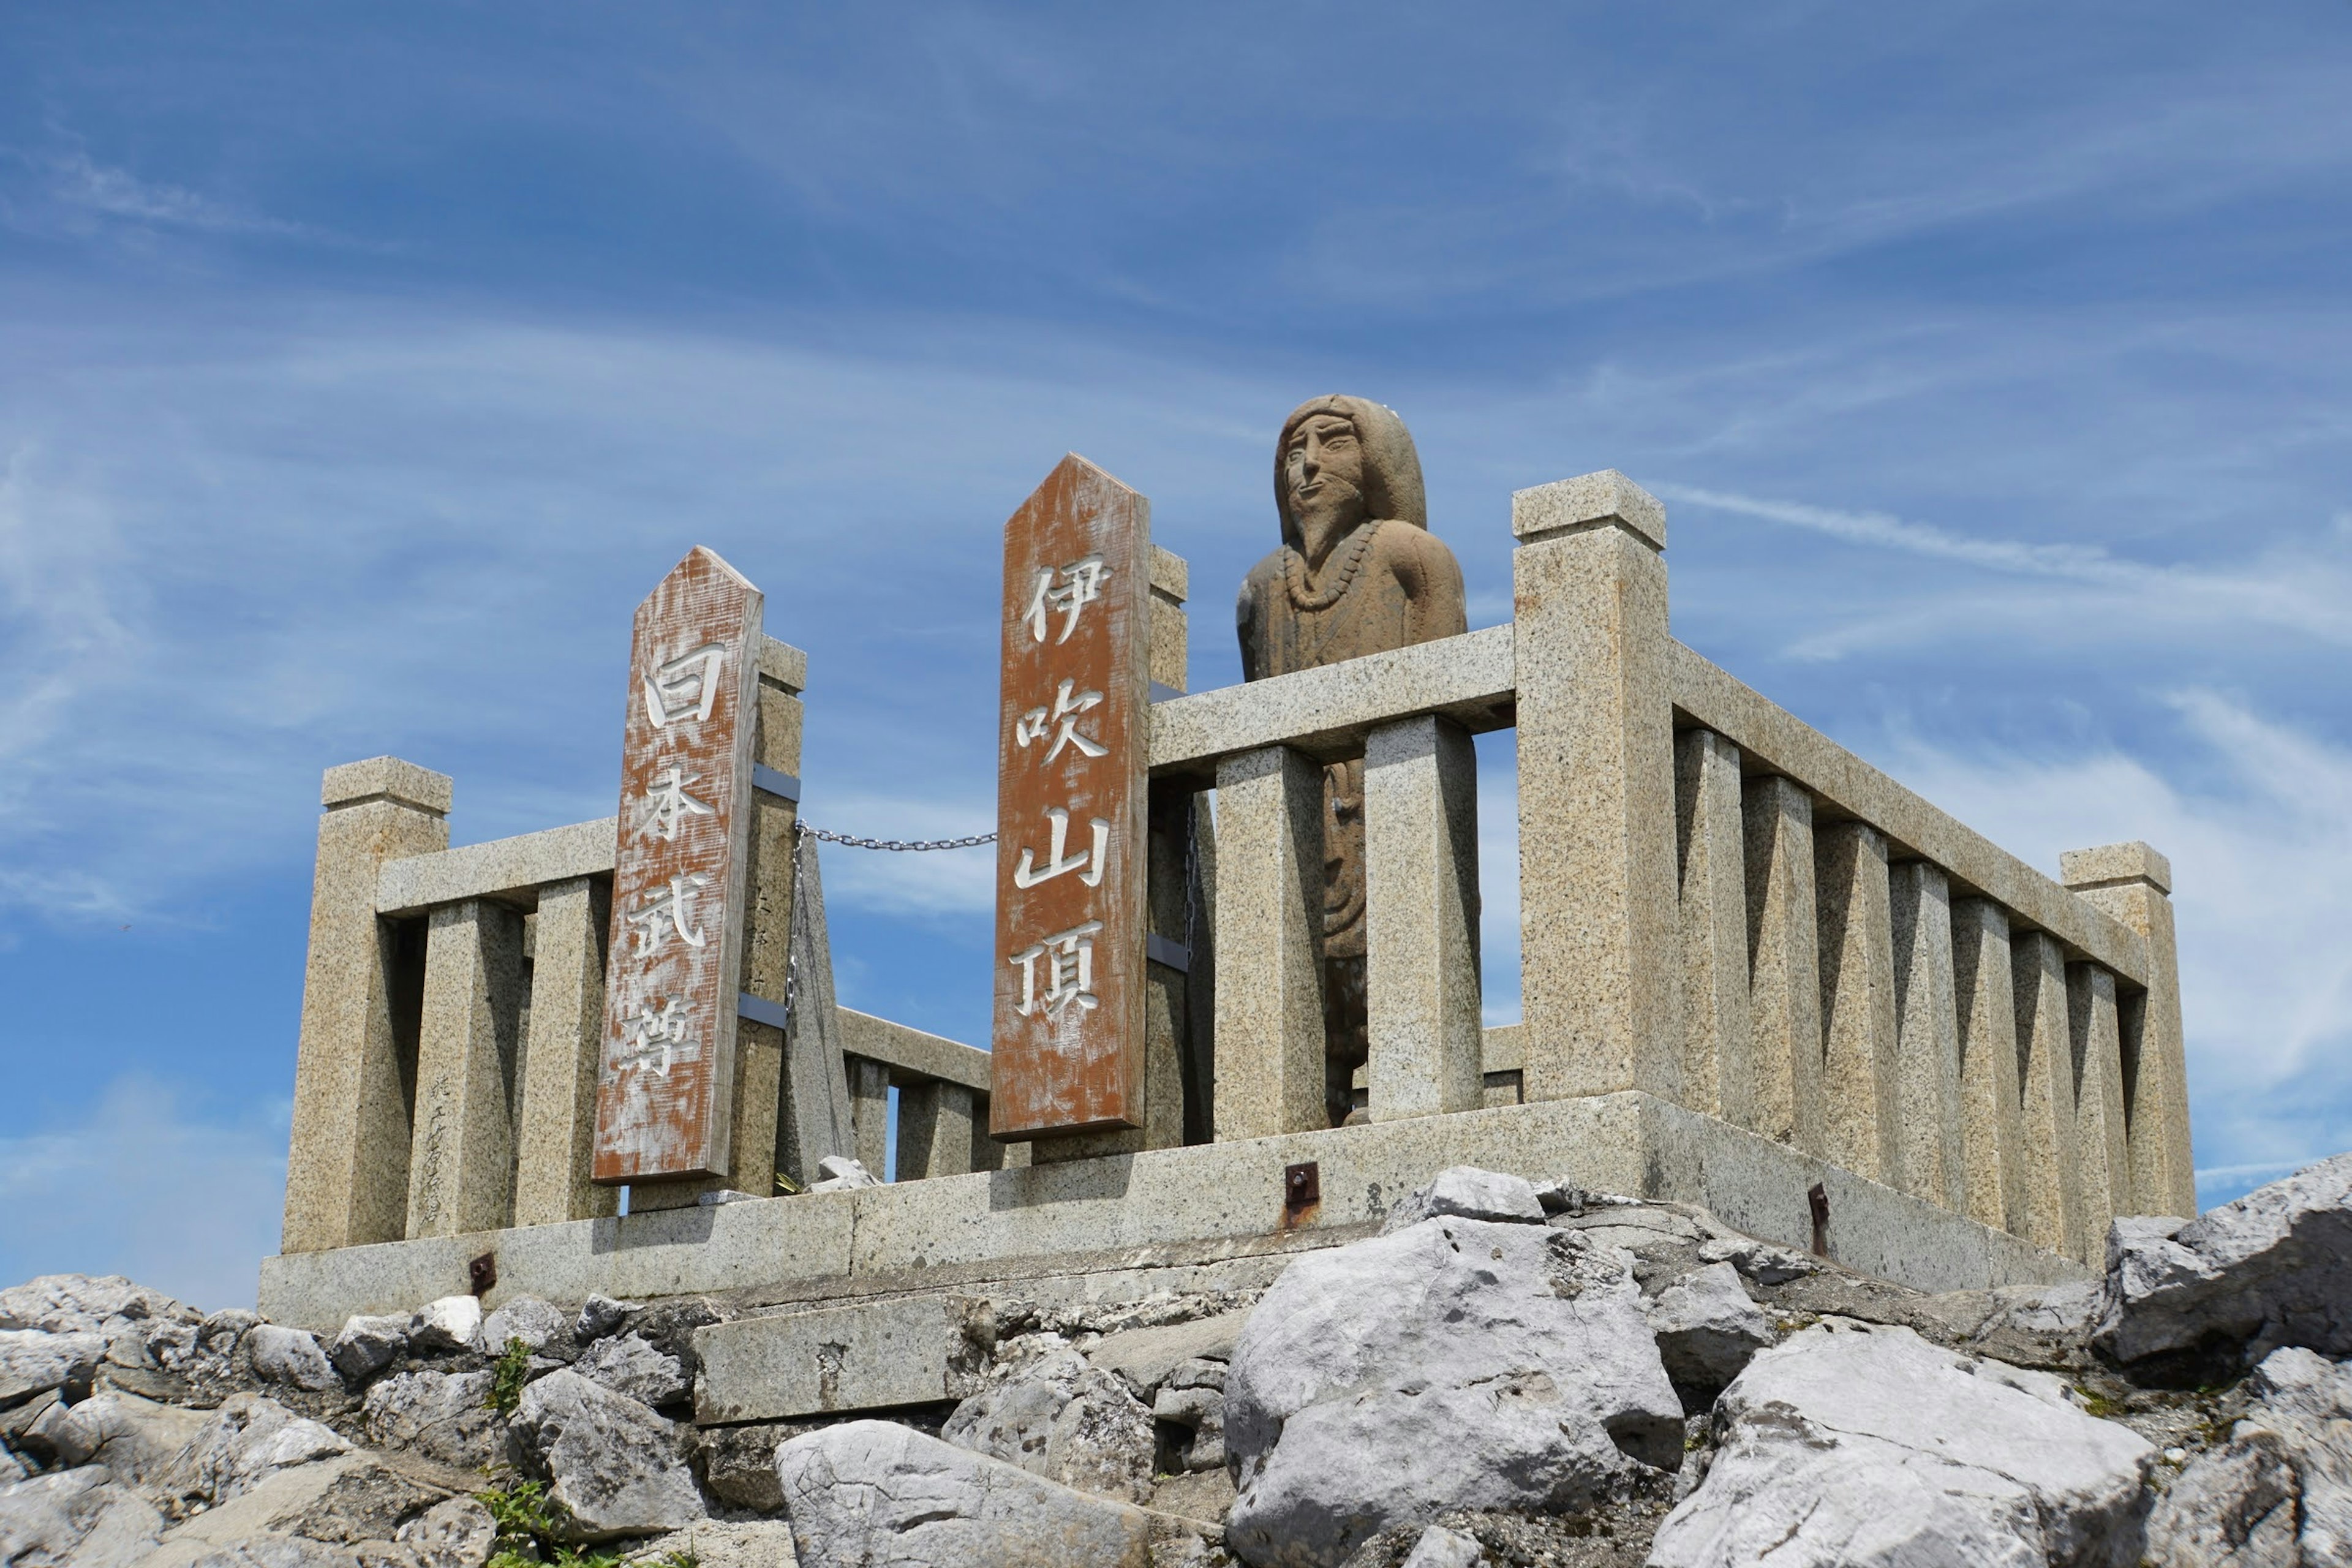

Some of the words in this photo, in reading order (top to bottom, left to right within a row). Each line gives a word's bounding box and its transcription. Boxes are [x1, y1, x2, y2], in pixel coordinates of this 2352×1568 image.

[617, 641, 726, 1078] 日本武尊
[1009, 551, 1114, 1016] 伊吹山頂
